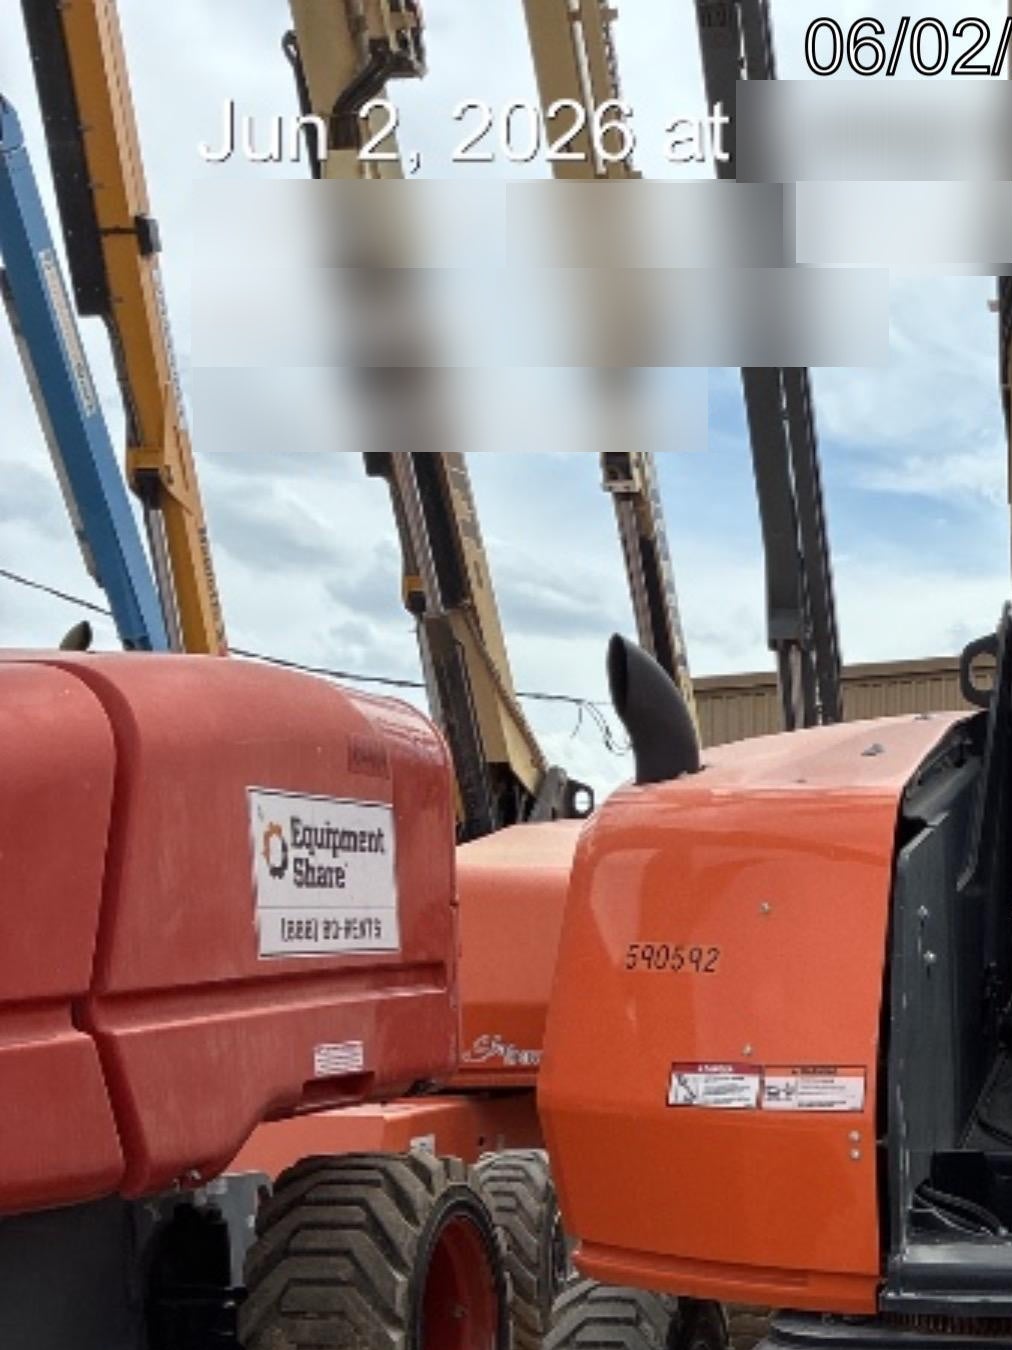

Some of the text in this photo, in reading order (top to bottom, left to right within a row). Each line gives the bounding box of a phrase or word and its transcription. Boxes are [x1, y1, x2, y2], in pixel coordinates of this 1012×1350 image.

[290, 816, 386, 858] Equipment
[293, 858, 347, 889] Share
[625, 943, 721, 973] 590592
